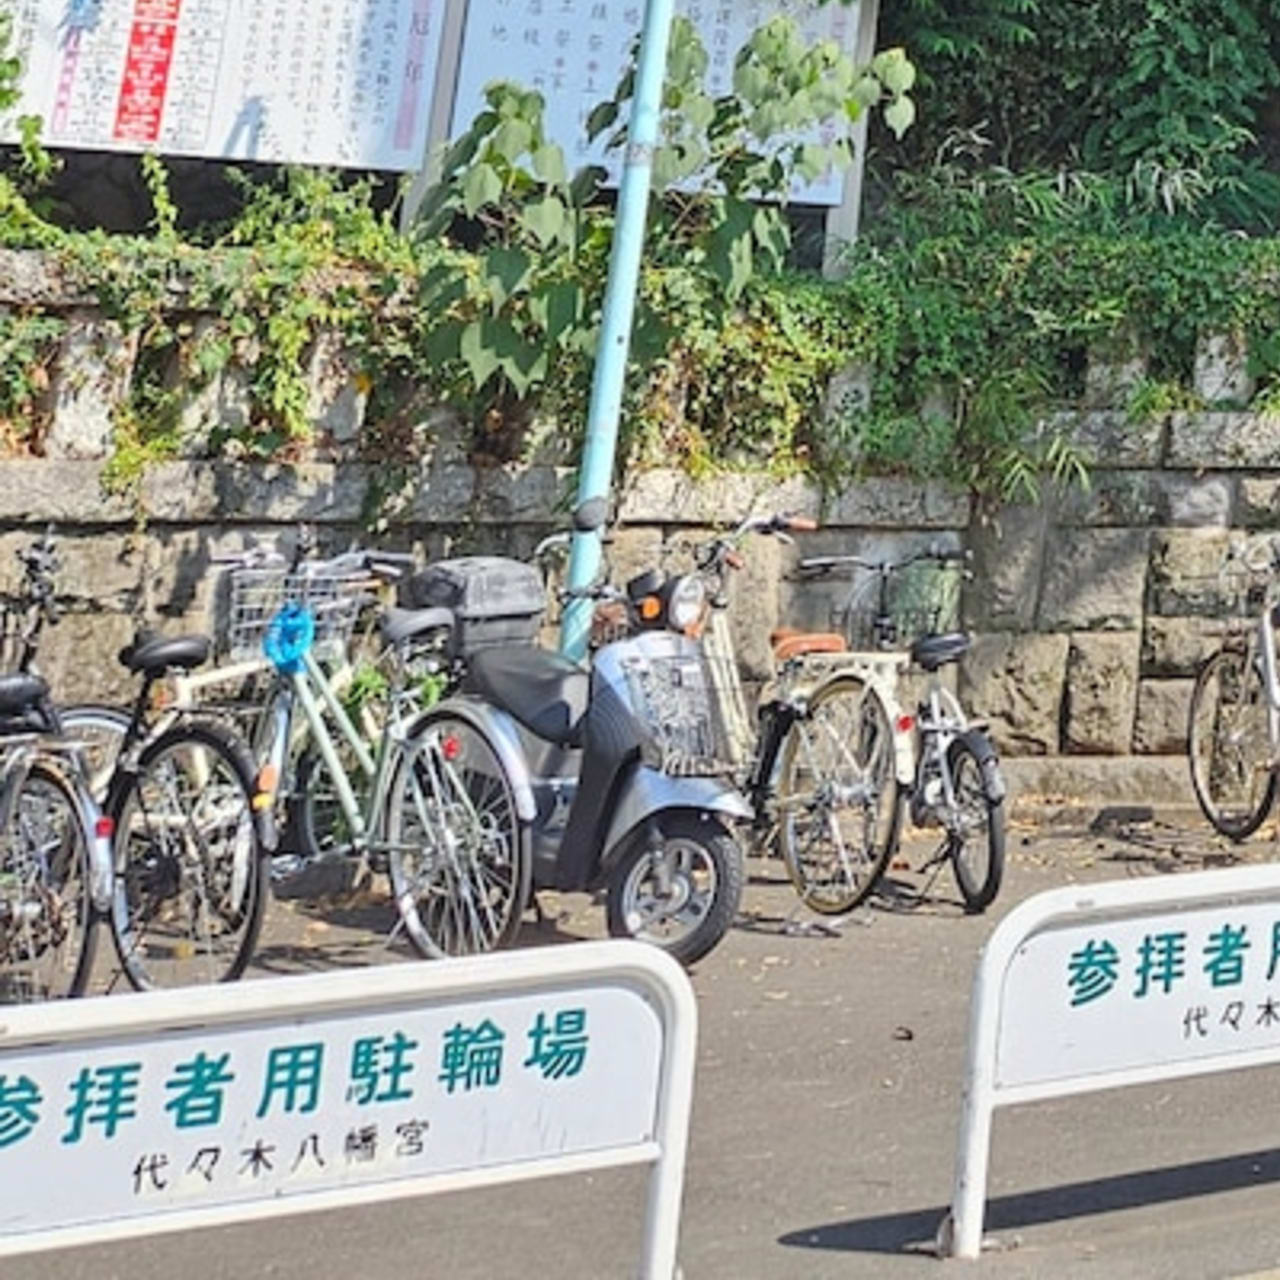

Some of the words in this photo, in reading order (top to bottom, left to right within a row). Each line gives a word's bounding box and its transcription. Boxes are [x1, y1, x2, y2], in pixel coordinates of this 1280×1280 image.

[0, 1007, 591, 1148] 参拝者用駐輪場
[131, 1118, 430, 1195] 代々木八幡宮
